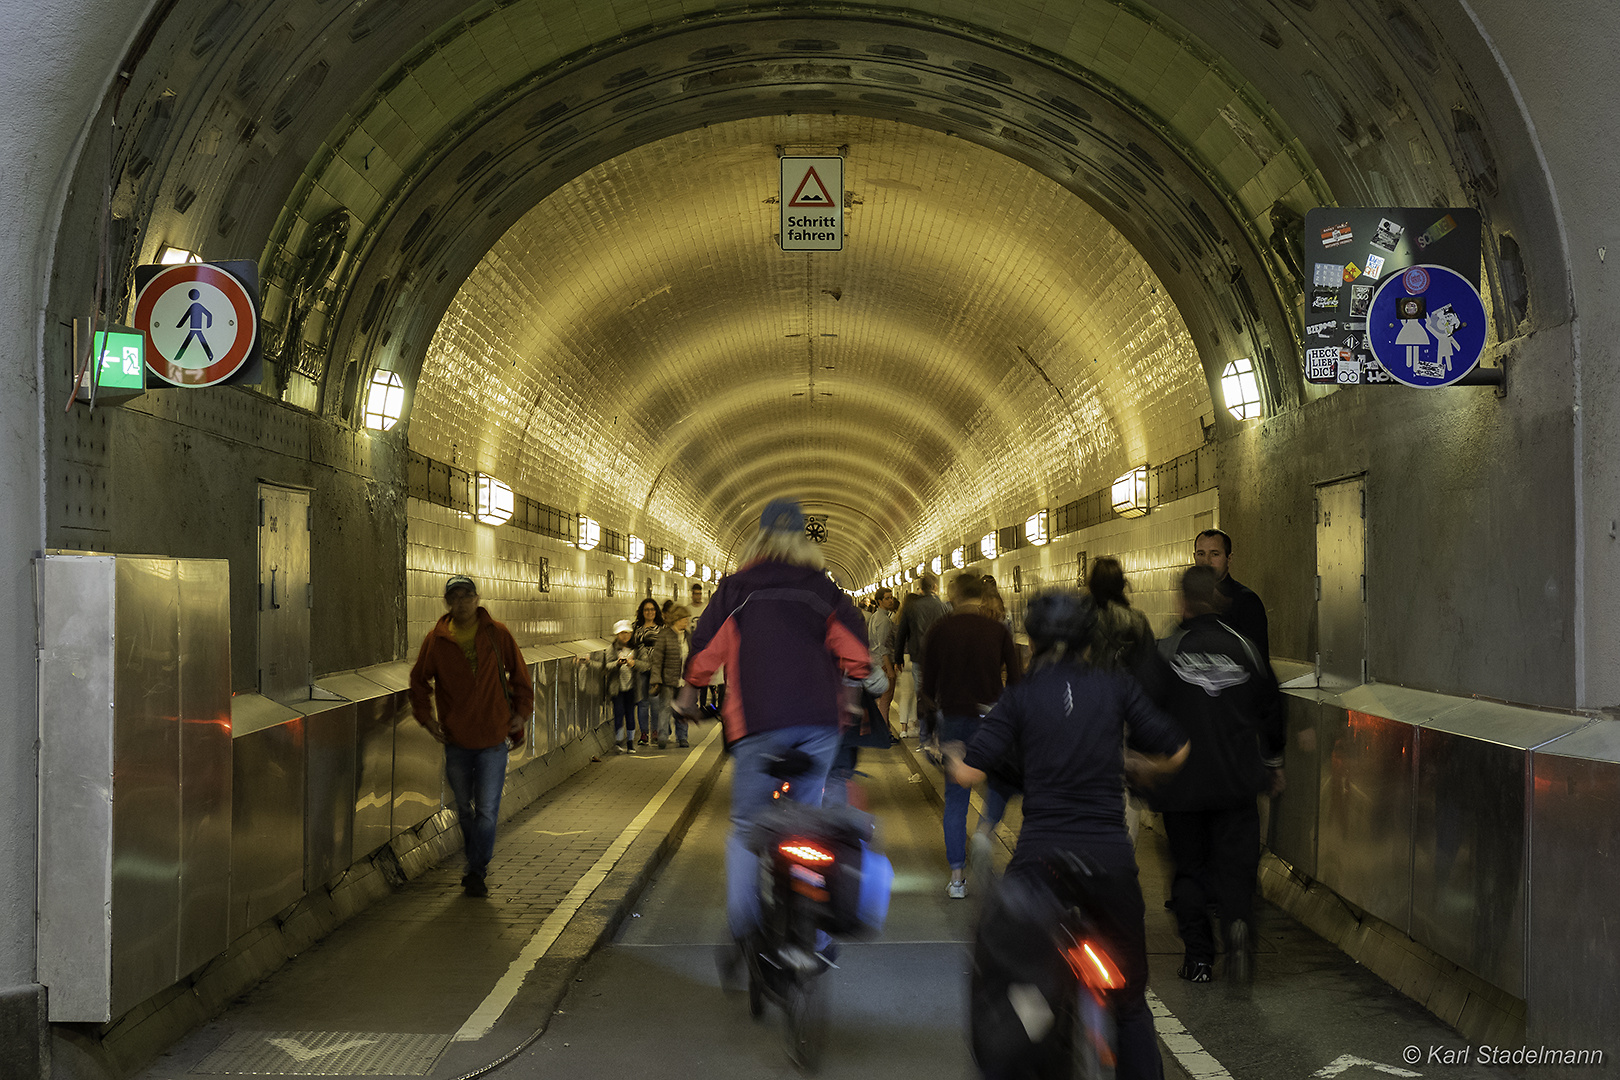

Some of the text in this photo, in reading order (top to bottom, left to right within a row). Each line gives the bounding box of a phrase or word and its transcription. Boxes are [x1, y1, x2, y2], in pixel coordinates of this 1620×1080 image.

[788, 216, 835, 227] Schritt
[788, 229, 835, 240] fahren
[1312, 349, 1338, 358] HECK
